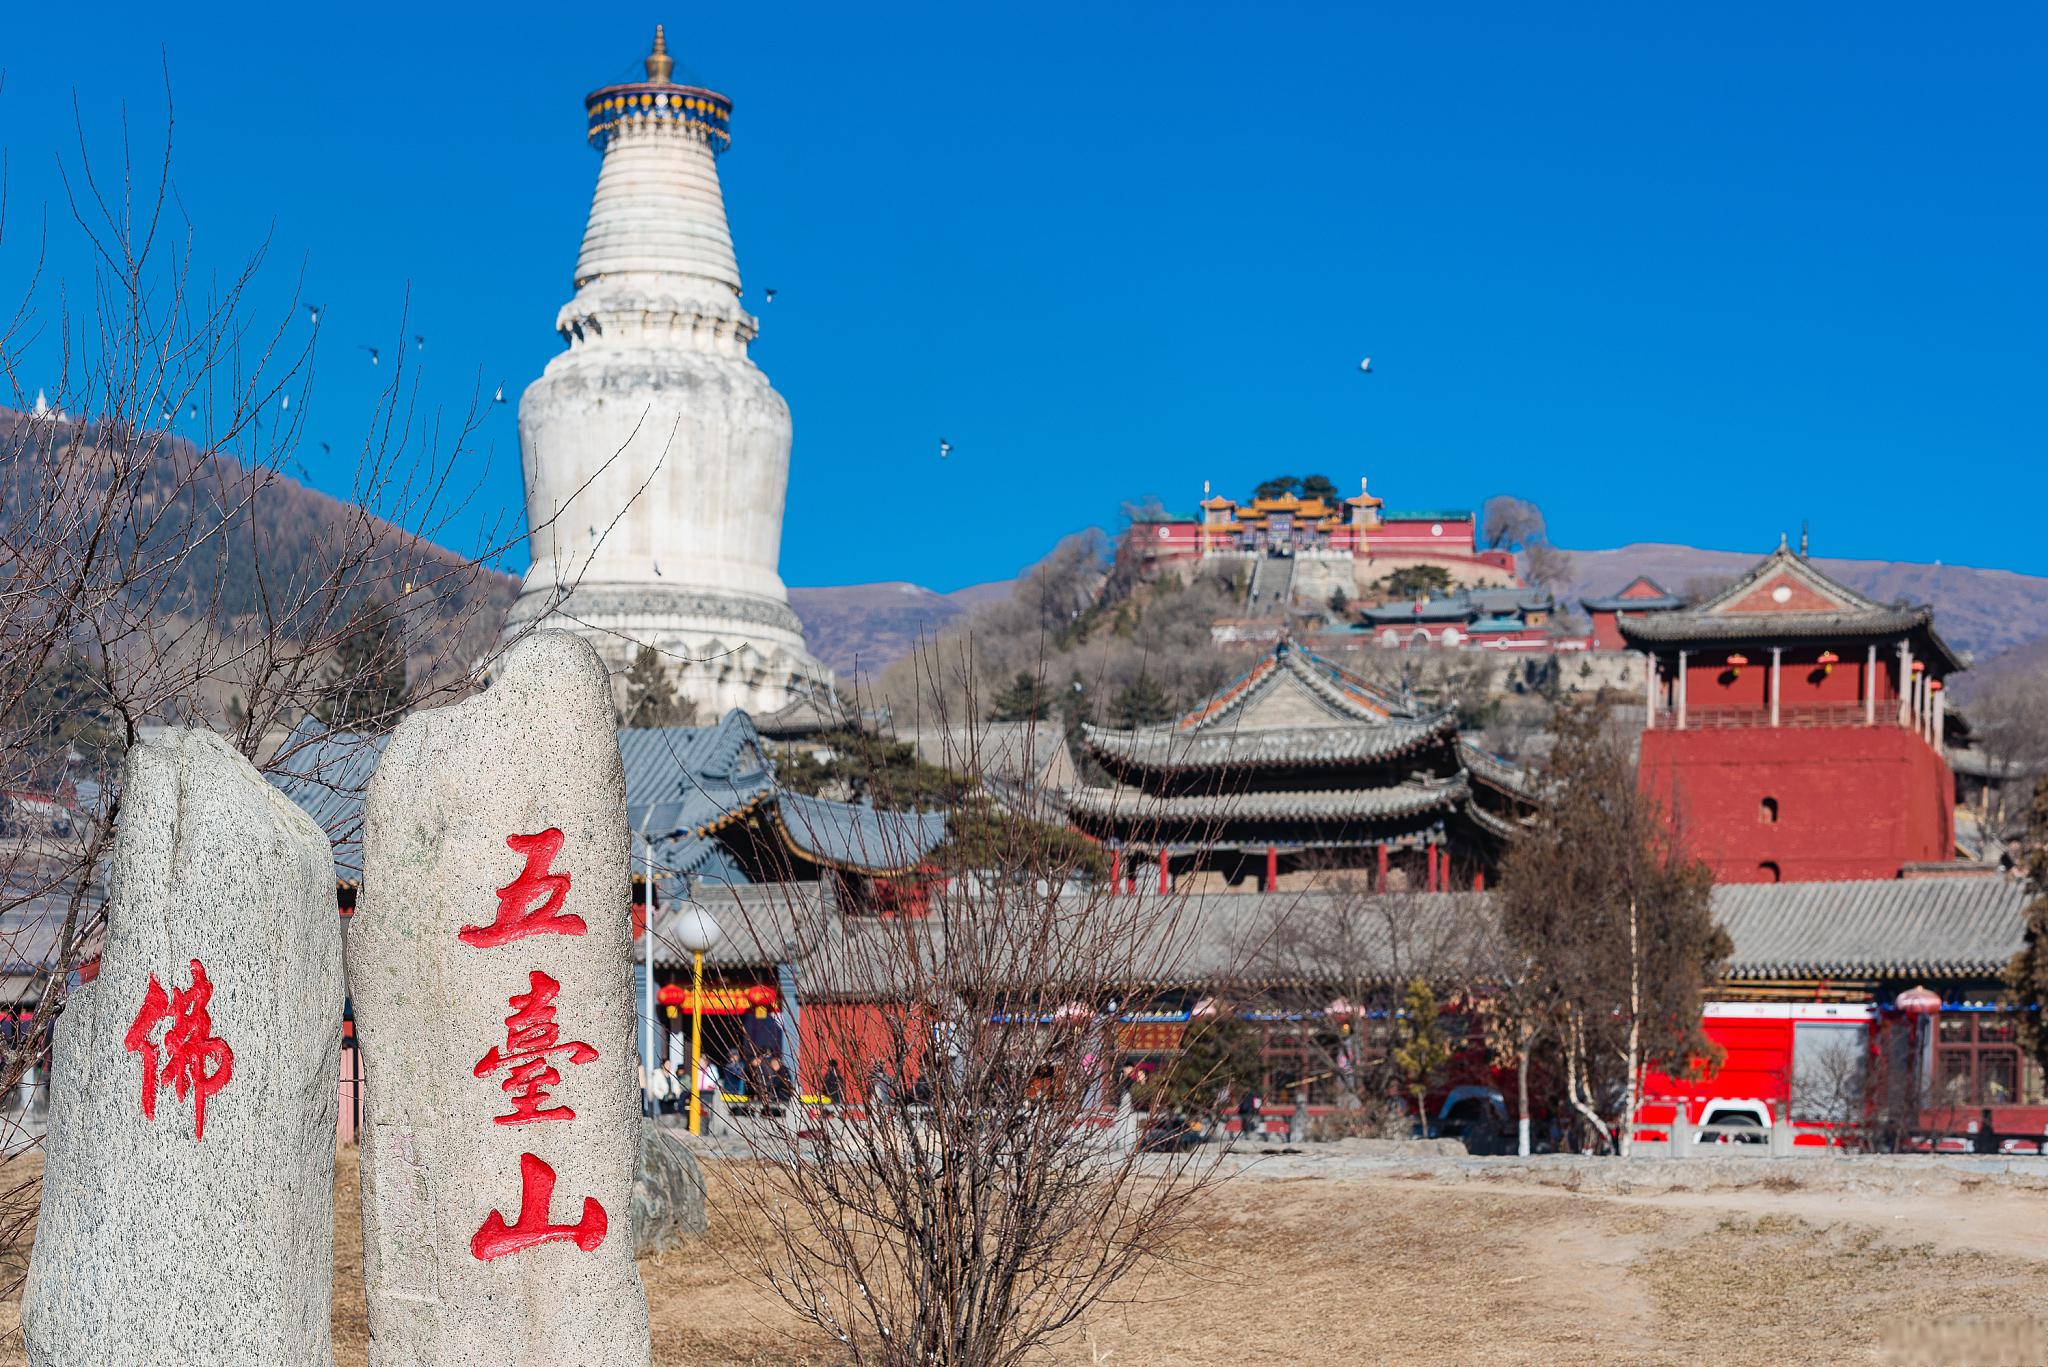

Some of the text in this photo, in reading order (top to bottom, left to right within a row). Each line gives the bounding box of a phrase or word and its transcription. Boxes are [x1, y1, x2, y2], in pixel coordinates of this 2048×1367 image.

[124, 959, 234, 1141] 佛
[458, 828, 608, 1261] 五臺山
